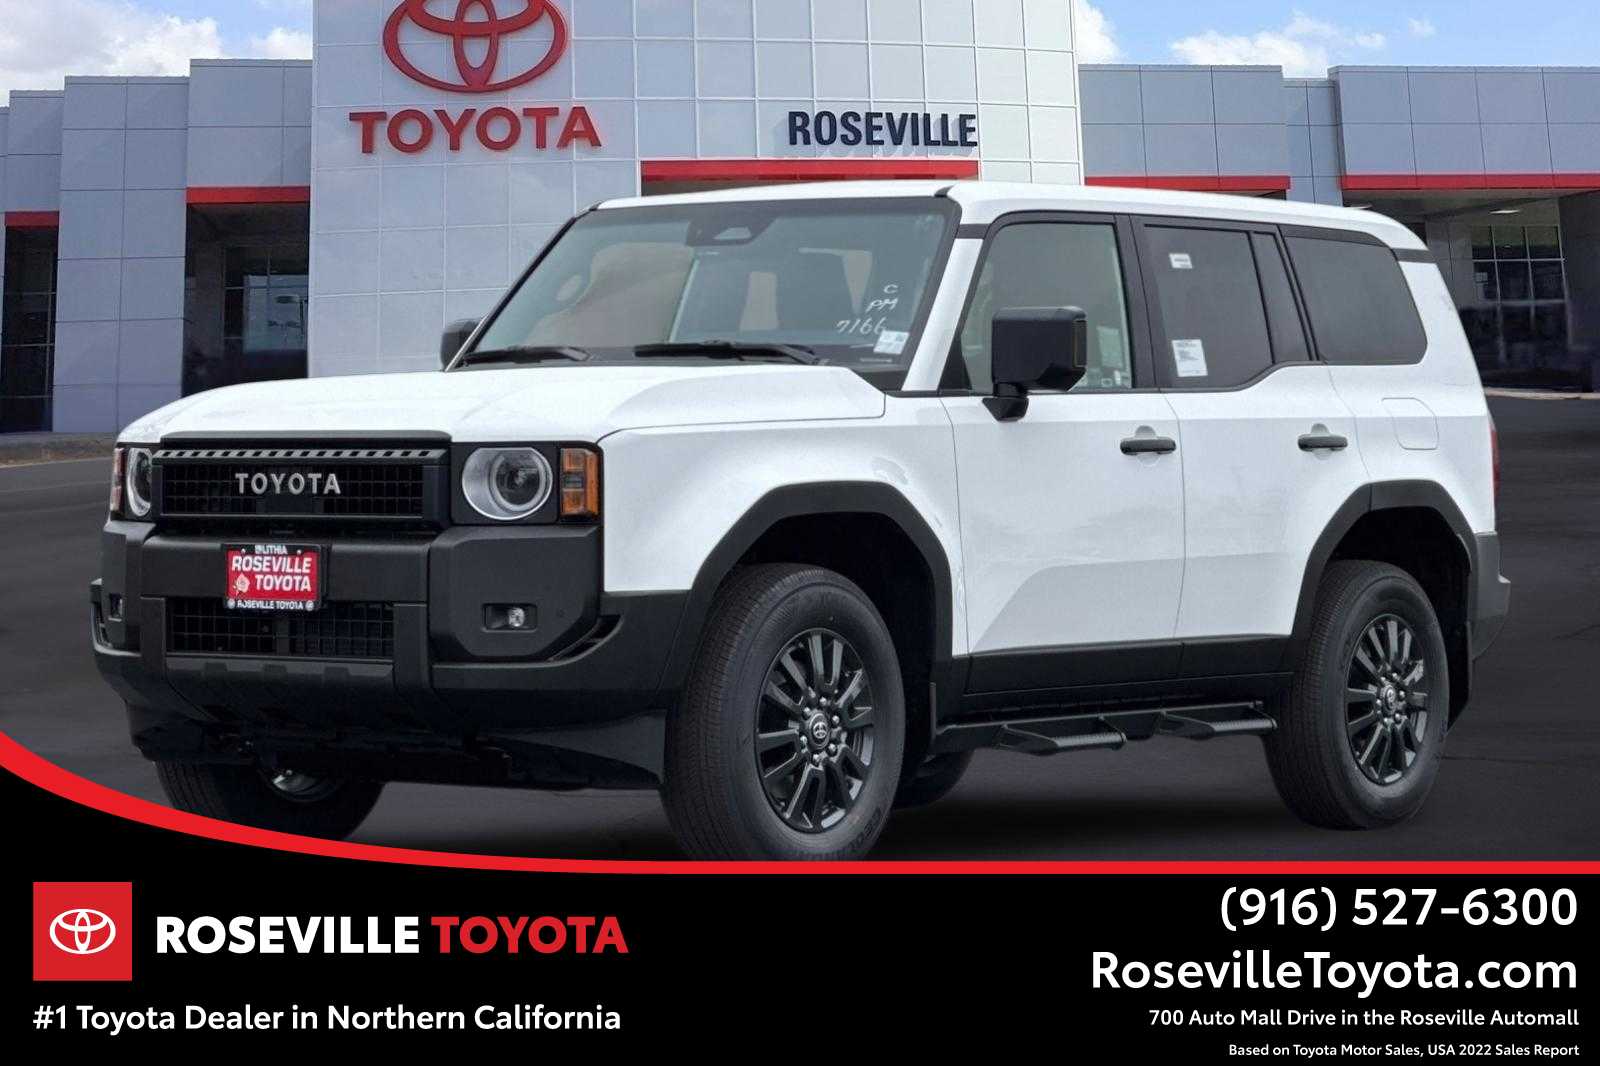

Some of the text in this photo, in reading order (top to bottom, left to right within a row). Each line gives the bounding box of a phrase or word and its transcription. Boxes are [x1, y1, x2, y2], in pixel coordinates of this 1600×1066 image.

[349, 106, 602, 154] TOYOTA
[788, 110, 978, 147] ROSEVILLE
[235, 472, 341, 495] TOYOTA
[231, 555, 313, 573] ROSEVILLE
[254, 574, 312, 592] TOYOTA
[237, 600, 304, 610] ROSEVILLE TOYOTA
